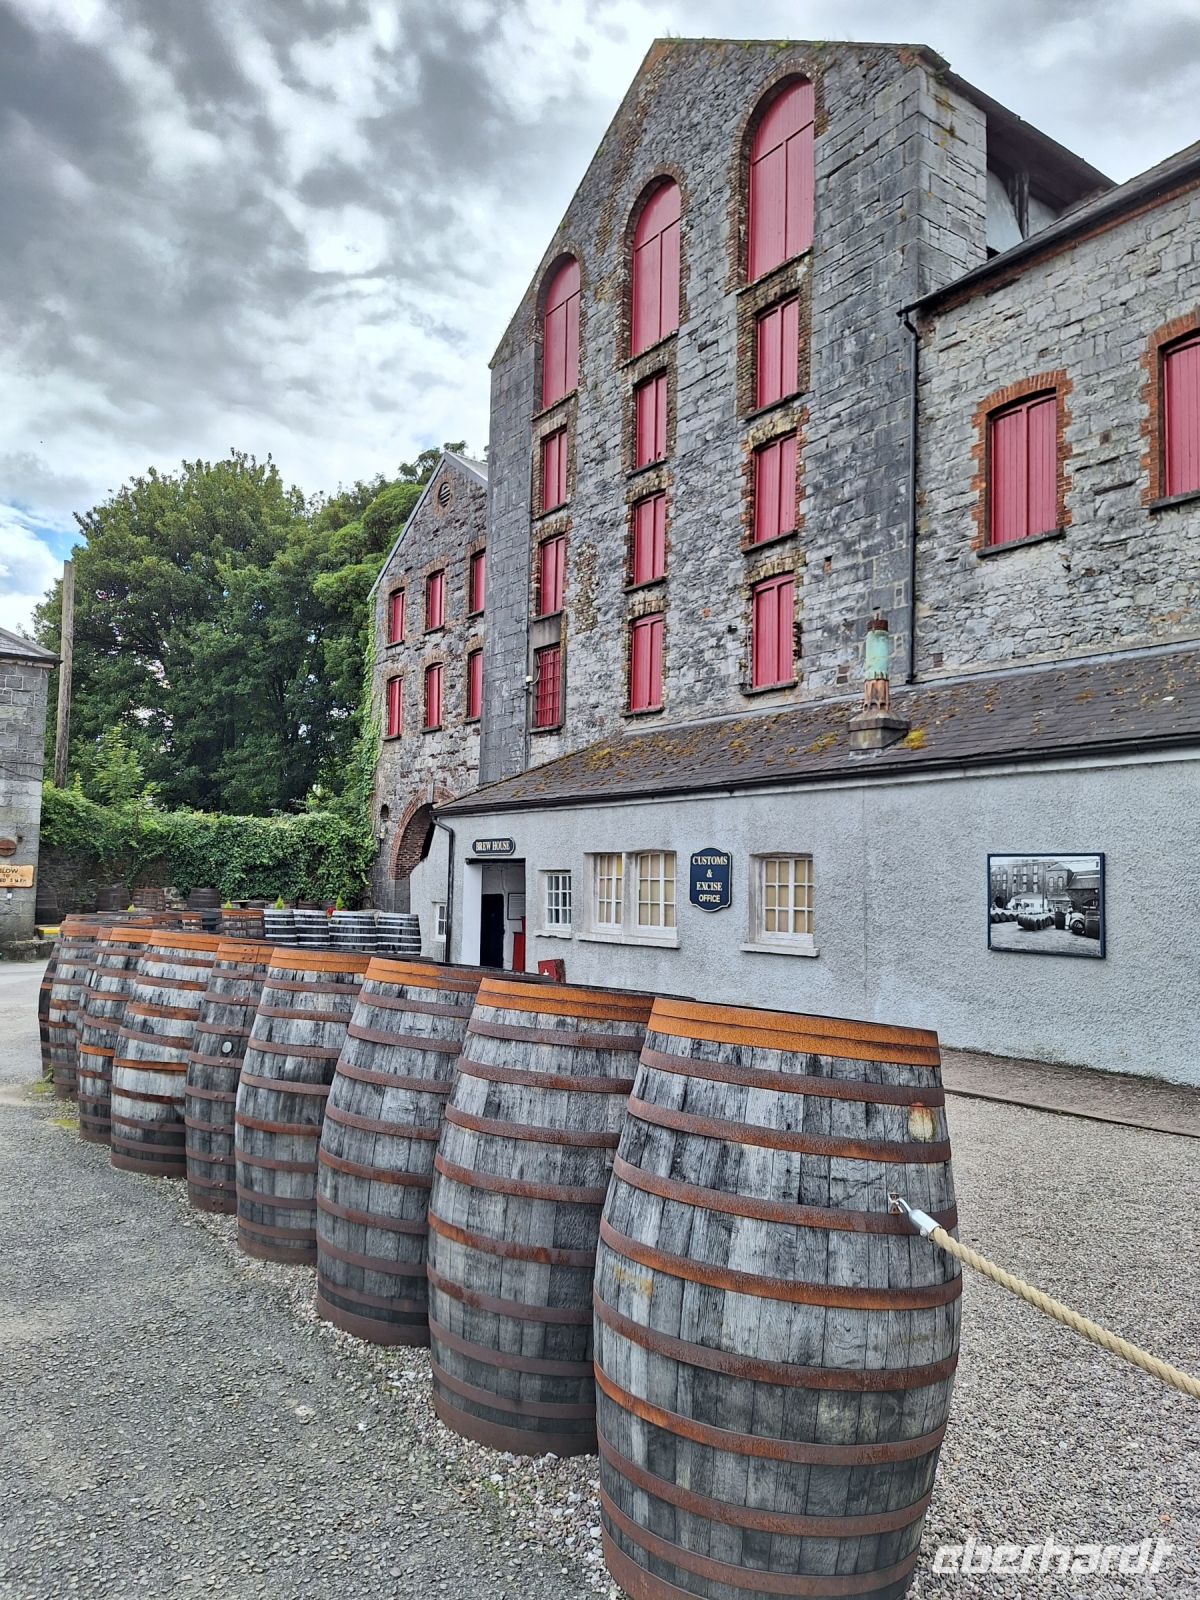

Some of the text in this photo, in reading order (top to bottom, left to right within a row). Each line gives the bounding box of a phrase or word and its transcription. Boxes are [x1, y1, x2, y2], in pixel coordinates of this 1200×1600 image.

[475, 840, 510, 851] BREW HOUSE
[692, 855, 728, 865] CUSTOMS
[706, 869, 713, 878] &
[696, 881, 723, 891] EXCISE
[698, 894, 720, 903] OFFICE
